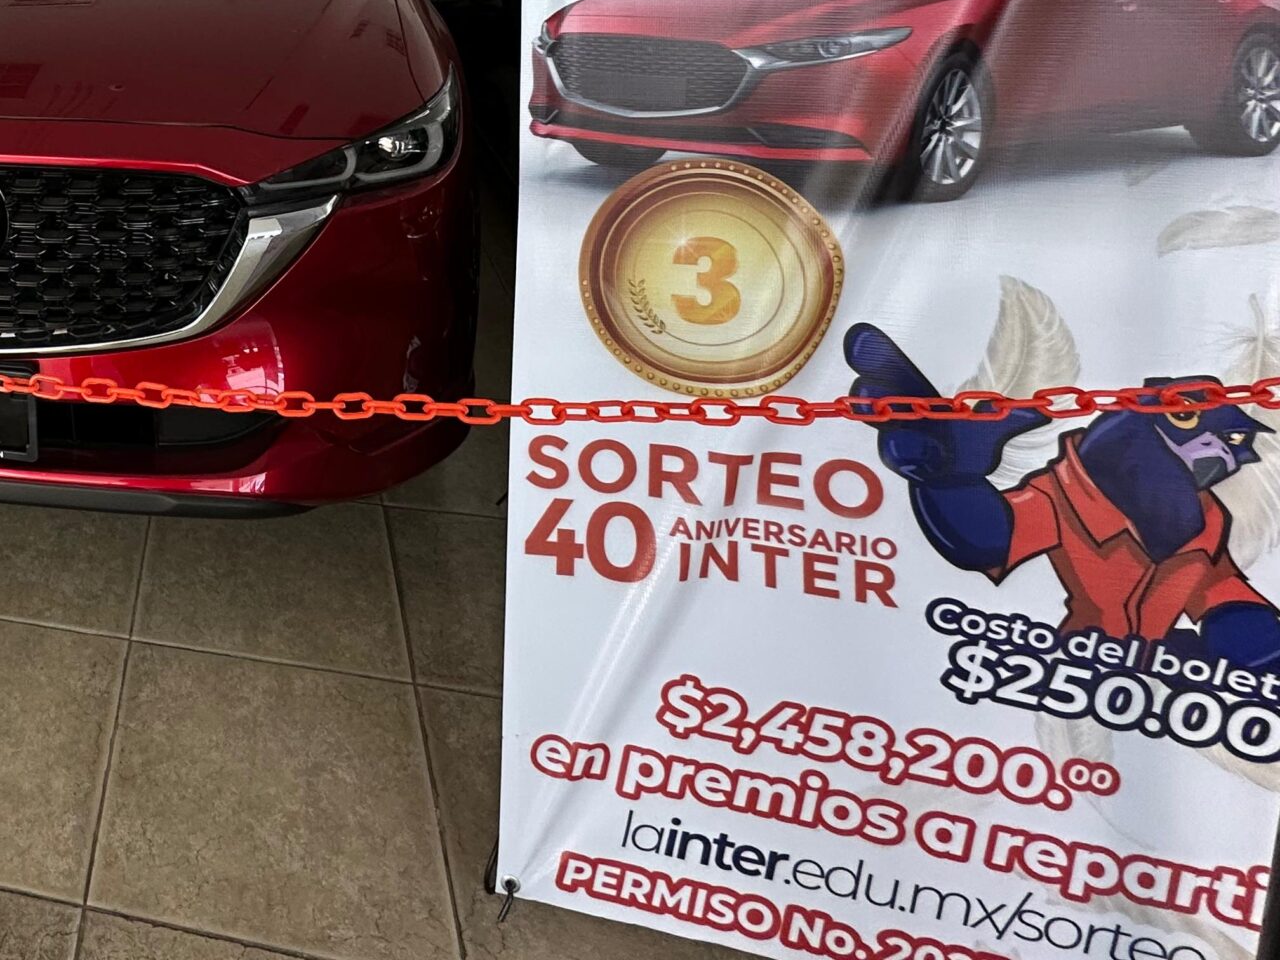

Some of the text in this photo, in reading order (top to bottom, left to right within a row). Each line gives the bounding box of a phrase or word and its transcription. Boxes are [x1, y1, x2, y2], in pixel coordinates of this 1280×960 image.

[670, 236, 743, 325] 3
[525, 434, 885, 520] SORTEO
[524, 498, 898, 584] 40 ANIVERSARIO
[678, 539, 900, 609] INTER
[932, 603, 1054, 649] Costo
[1067, 632, 1140, 668] del
[662, 680, 1116, 808] $2,458,200.00
[947, 640, 1280, 759] $250.00
[537, 740, 605, 779] en
[624, 747, 901, 839] premios
[922, 816, 969, 857] a
[563, 859, 867, 960] PERMISO No.
